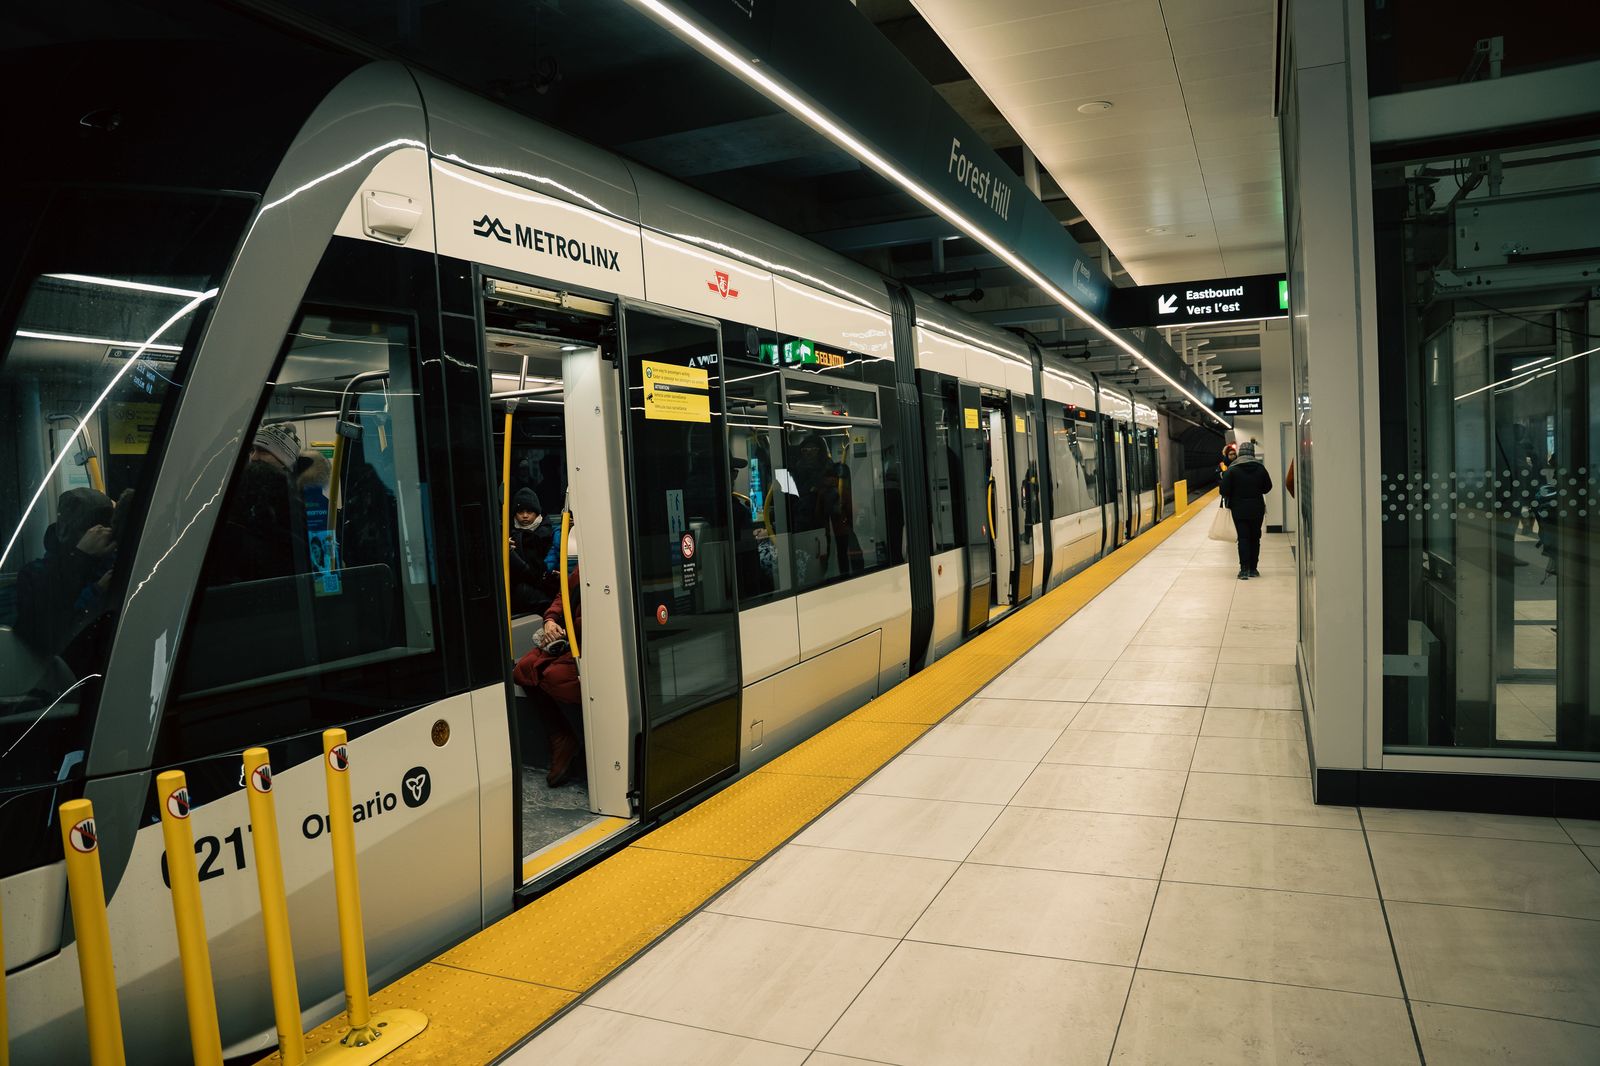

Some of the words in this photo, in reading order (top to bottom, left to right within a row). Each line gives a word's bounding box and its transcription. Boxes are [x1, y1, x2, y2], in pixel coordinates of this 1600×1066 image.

[948, 137, 990, 202] Forest
[991, 177, 1012, 222] Hill
[515, 223, 621, 272] METROLINX
[1186, 286, 1243, 300] Eastbound
[1187, 305, 1210, 315] Vers
[1215, 302, 1240, 313] l'est
[302, 790, 397, 839] Oario
[161, 824, 253, 889] 21
